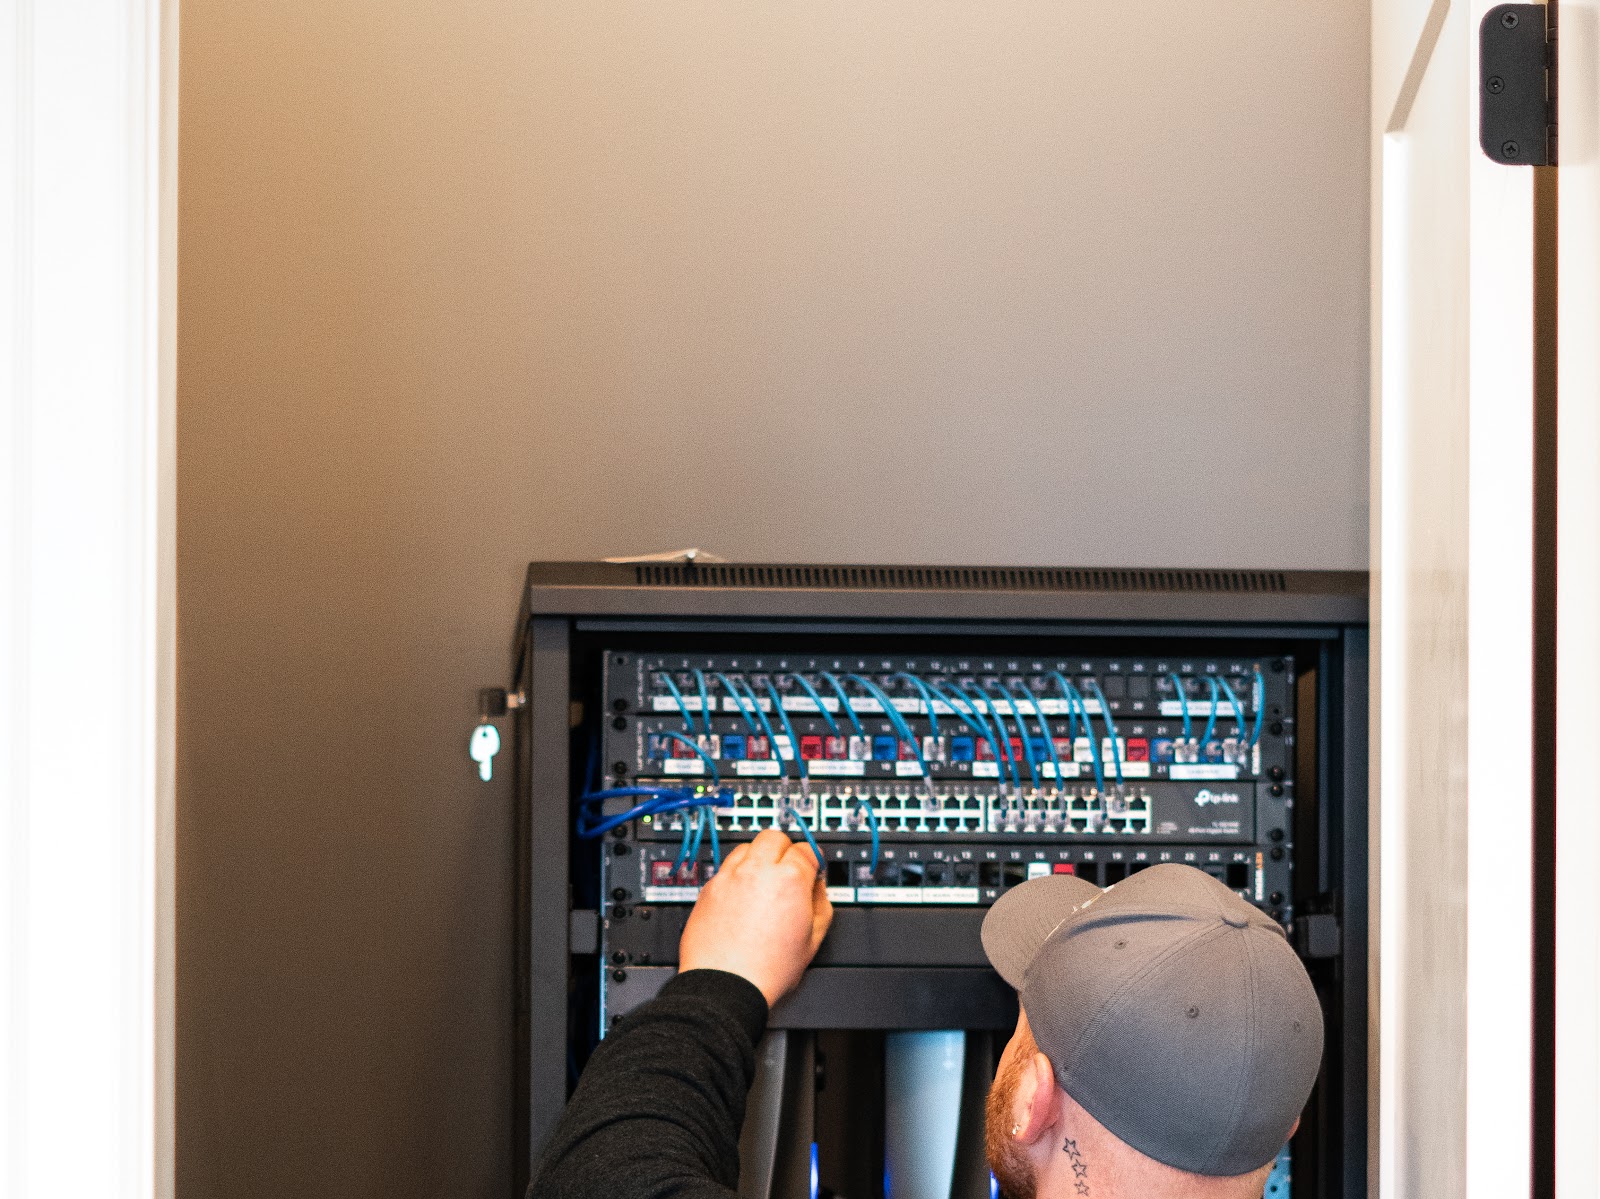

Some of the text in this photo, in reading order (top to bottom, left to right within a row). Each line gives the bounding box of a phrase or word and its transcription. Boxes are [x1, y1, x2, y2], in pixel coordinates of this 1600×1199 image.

[1210, 792, 1239, 805] tp-link
[884, 850, 895, 859] 10
[908, 851, 919, 859] 11
[933, 850, 944, 860] 12
[961, 851, 972, 860] 13
[986, 851, 997, 859] 14
[1010, 851, 1021, 860] 15
[1035, 852, 1045, 860] 16
[1059, 851, 1069, 860] 17
[1083, 851, 1094, 861] 18
[1112, 851, 1123, 860] 19
[1135, 851, 1147, 861] 20
[1160, 852, 1171, 861] 21
[1184, 852, 1196, 861] 22
[1208, 852, 1220, 862] 23
[1232, 852, 1244, 862] 24
